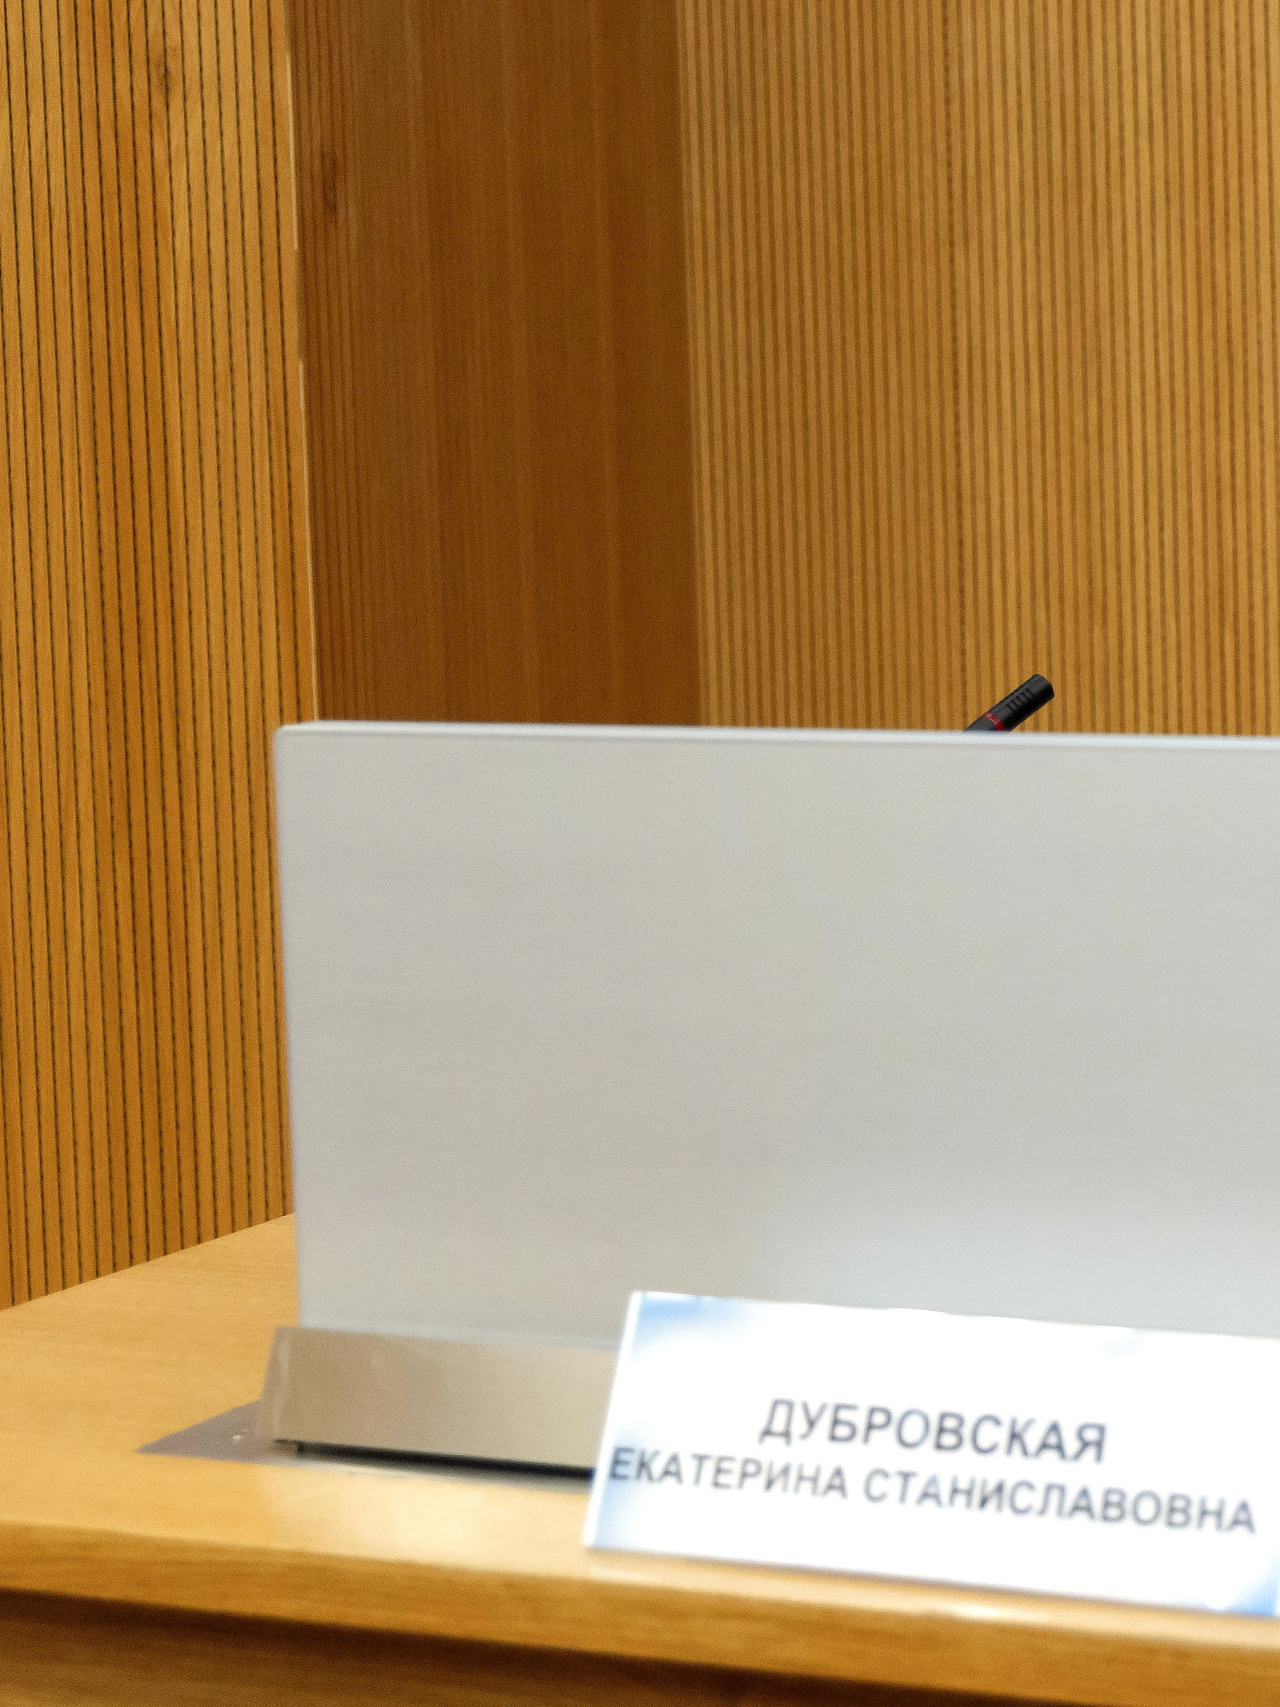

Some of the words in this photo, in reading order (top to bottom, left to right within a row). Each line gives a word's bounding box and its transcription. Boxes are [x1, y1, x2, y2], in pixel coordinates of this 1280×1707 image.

[760, 1398, 1107, 1463] ДУБРОВСКАЯ
[608, 1446, 849, 1499] ЕКАТЕРИНА
[864, 1468, 1256, 1535] СТАНИСЛАВОВНА
